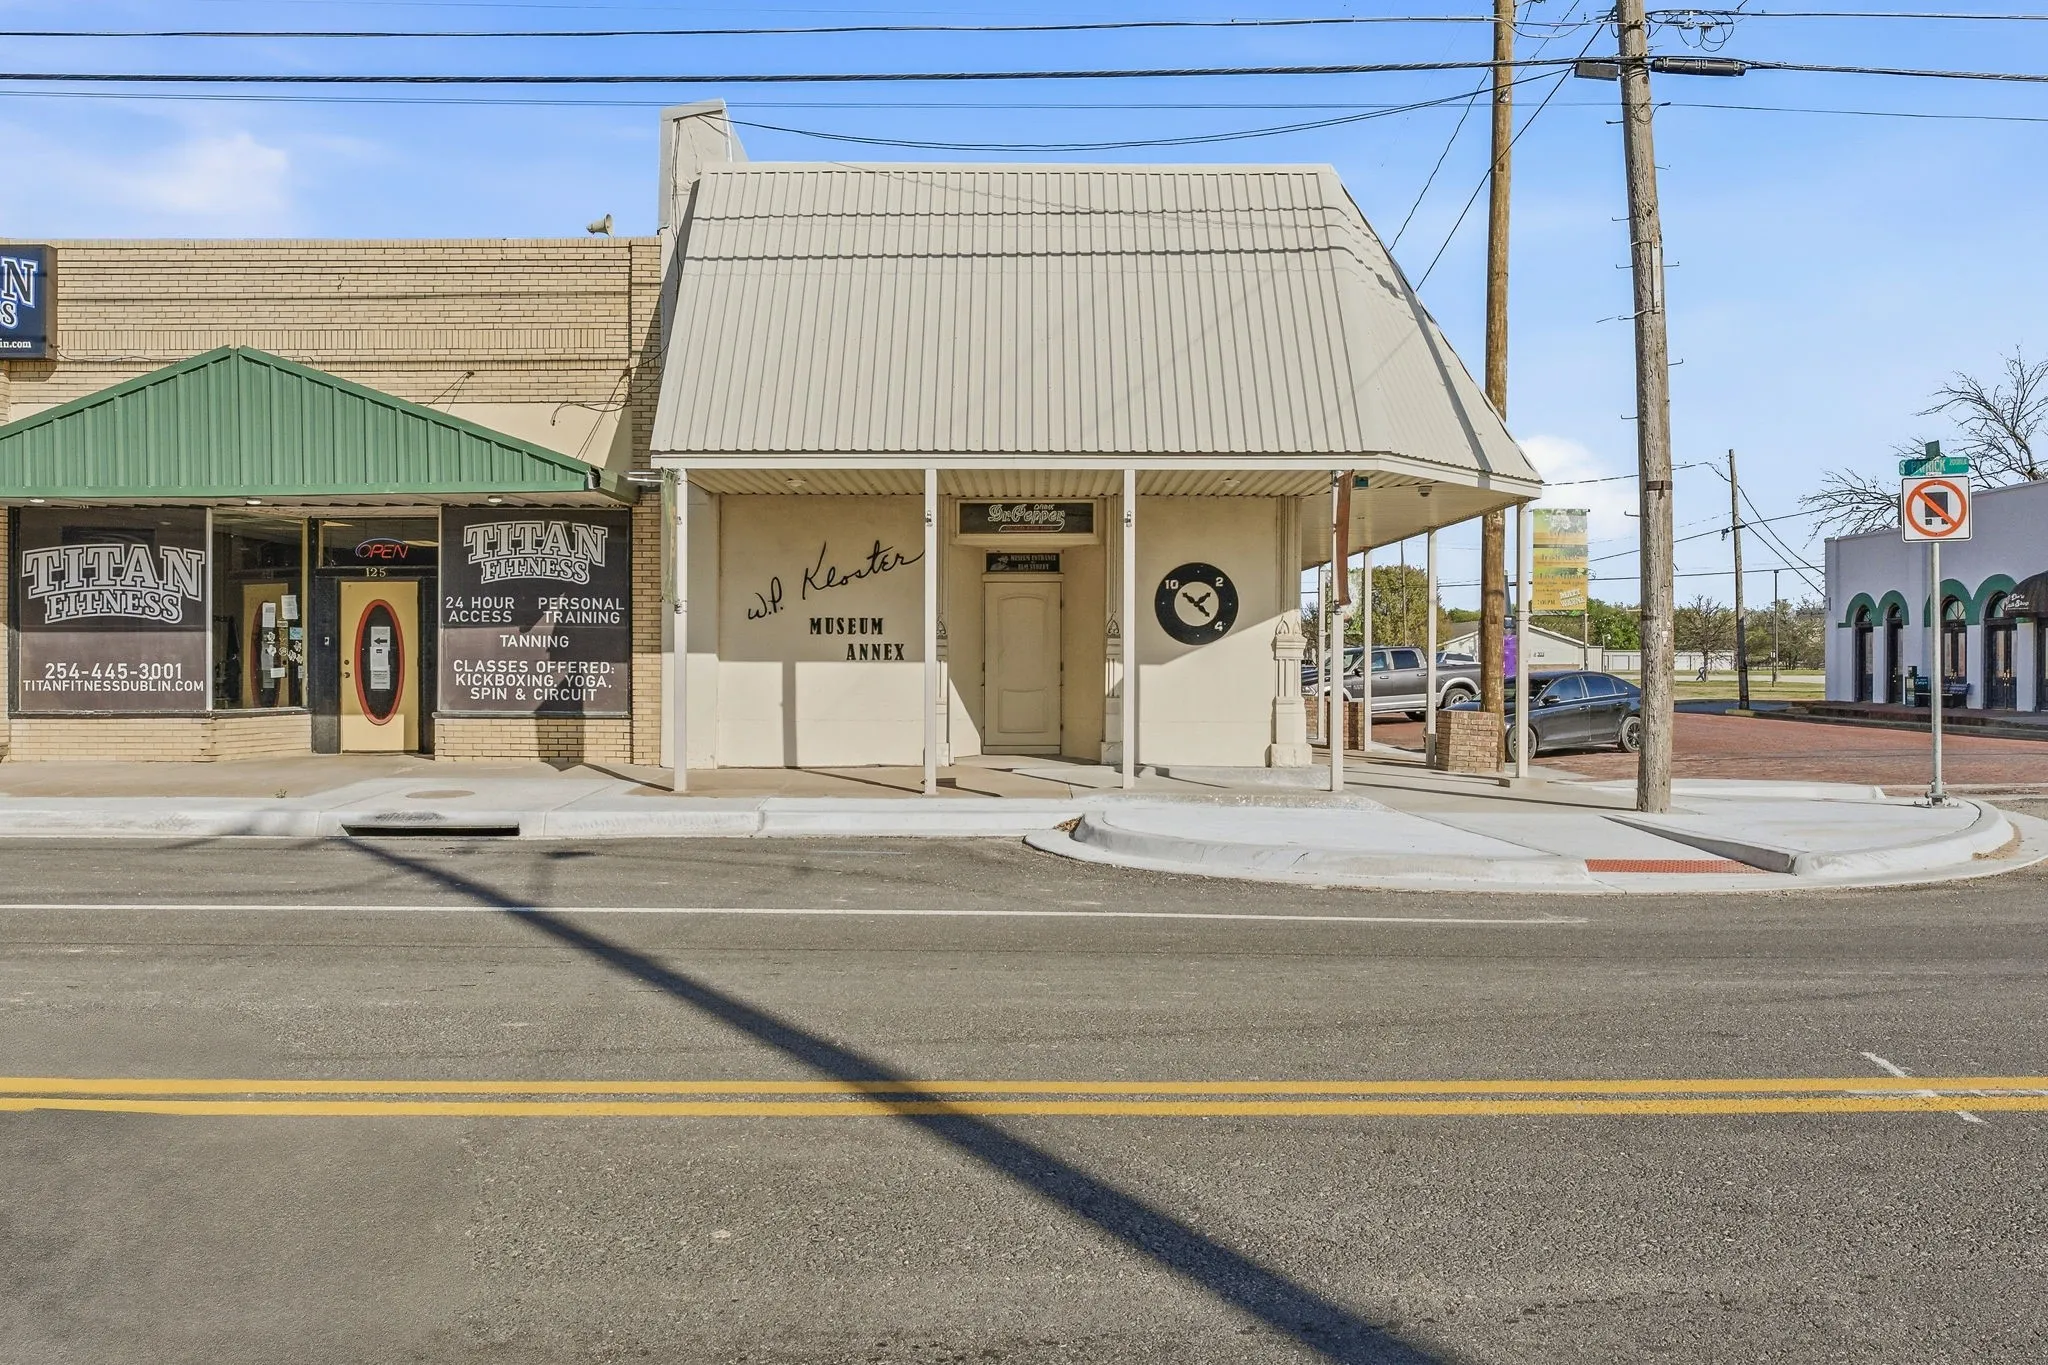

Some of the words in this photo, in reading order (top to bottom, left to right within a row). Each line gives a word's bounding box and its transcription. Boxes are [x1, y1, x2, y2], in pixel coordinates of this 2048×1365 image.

[1011, 504, 1066, 525] Pepper
[358, 543, 409, 559] OPEN
[463, 520, 608, 567] TITAN
[21, 544, 205, 601] TITAN
[366, 567, 386, 578] 125
[481, 556, 590, 585] FITNESS
[801, 539, 926, 601] Kloster
[1165, 579, 1178, 590] 10
[1215, 576, 1224, 587] 2
[45, 589, 183, 624] FITNESS
[445, 596, 464, 609] 24
[471, 596, 515, 609] HOUR
[538, 597, 625, 610] PERSONAL
[449, 610, 513, 623] ACCESS
[543, 611, 621, 624] TRAINING
[809, 617, 884, 635] MUSEUM
[1214, 621, 1223, 632] 4
[500, 634, 569, 648] TANNING
[846, 643, 905, 661] ANNEX
[45, 662, 182, 680] 254-445-3001
[453, 659, 528, 673] CLASSES
[536, 660, 615, 674] OFFERED:
[22, 679, 204, 692] TITANFITNESSDUBLIN.COM
[470, 687, 507, 701] SPIN
[515, 688, 526, 700] &
[534, 688, 597, 702] CIRCUIT
